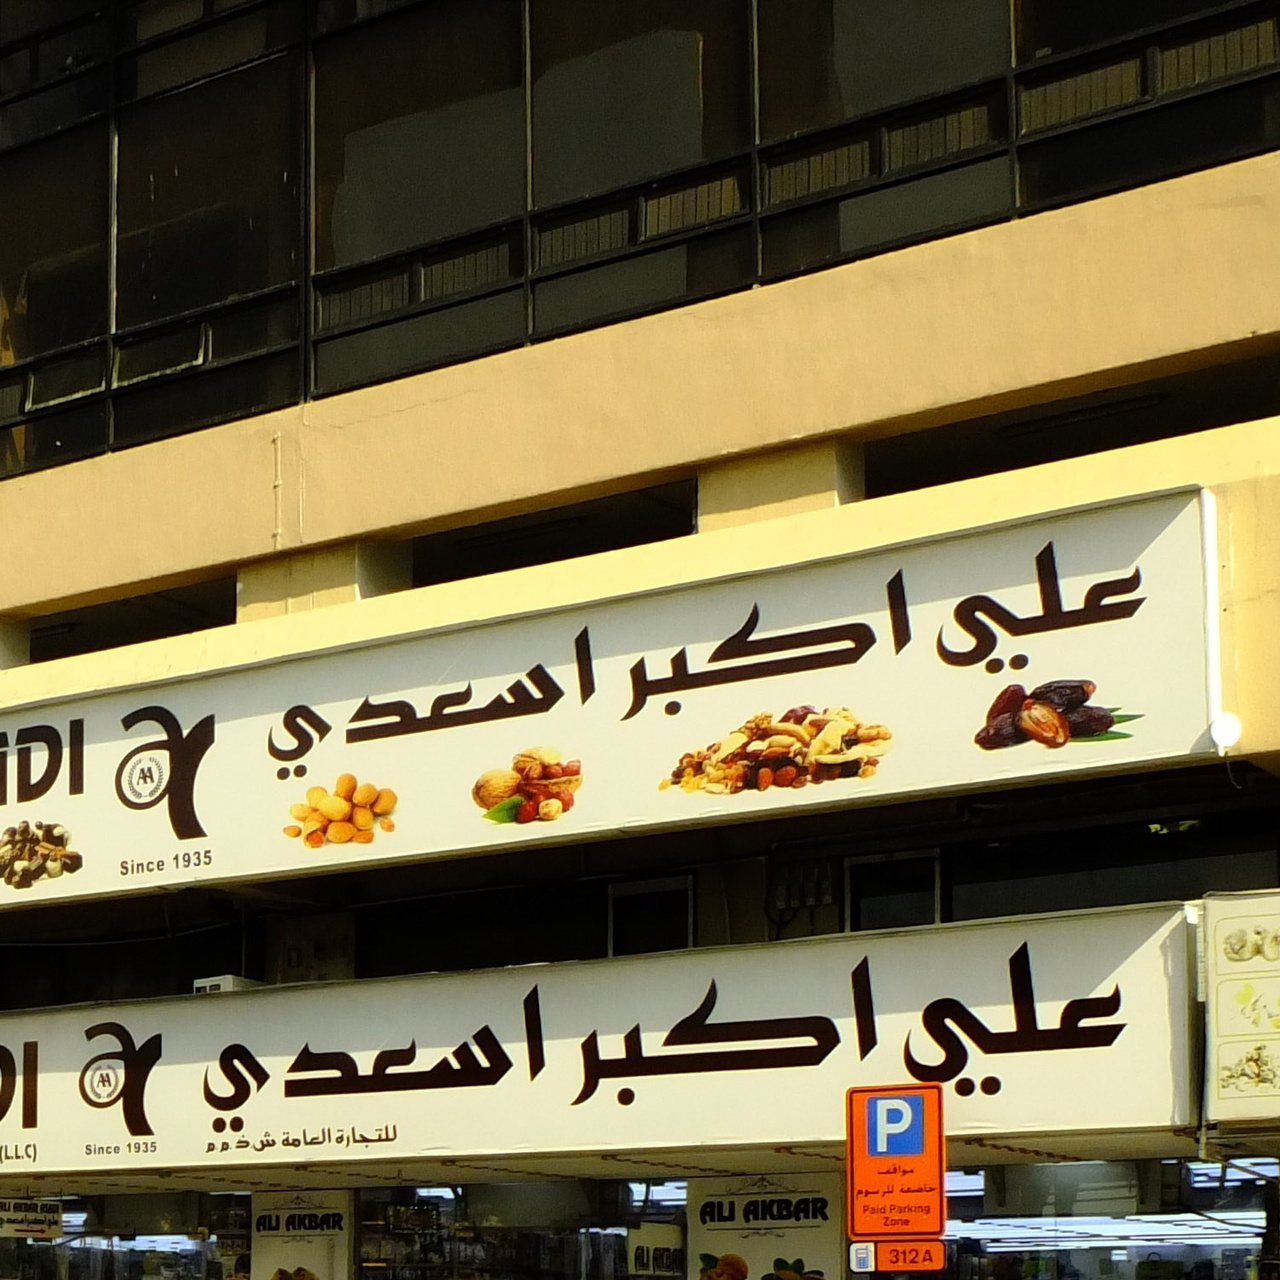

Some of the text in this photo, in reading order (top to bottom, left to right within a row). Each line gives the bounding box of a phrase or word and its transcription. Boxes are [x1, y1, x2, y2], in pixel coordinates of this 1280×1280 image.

[268, 541, 1147, 781] علي اكبر اسعدي
[120, 850, 213, 876] Since 1935
[203, 940, 1128, 1133] علي اكبر اسعدي
[876, 1099, 913, 1153] P
[282, 1128, 332, 1148] العامة
[336, 1124, 397, 1149] للتجارة
[0, 1143, 38, 1163] (L.L.C)
[85, 1141, 157, 1156] Since 1935
[877, 1163, 915, 1176] مواقف
[700, 1197, 829, 1224] ALI AKBAR
[863, 1203, 931, 1217] Paid Parking
[256, 1213, 344, 1232] ALI AKBAR
[883, 1216, 911, 1228] Zone
[889, 1248, 934, 1265] 312A
